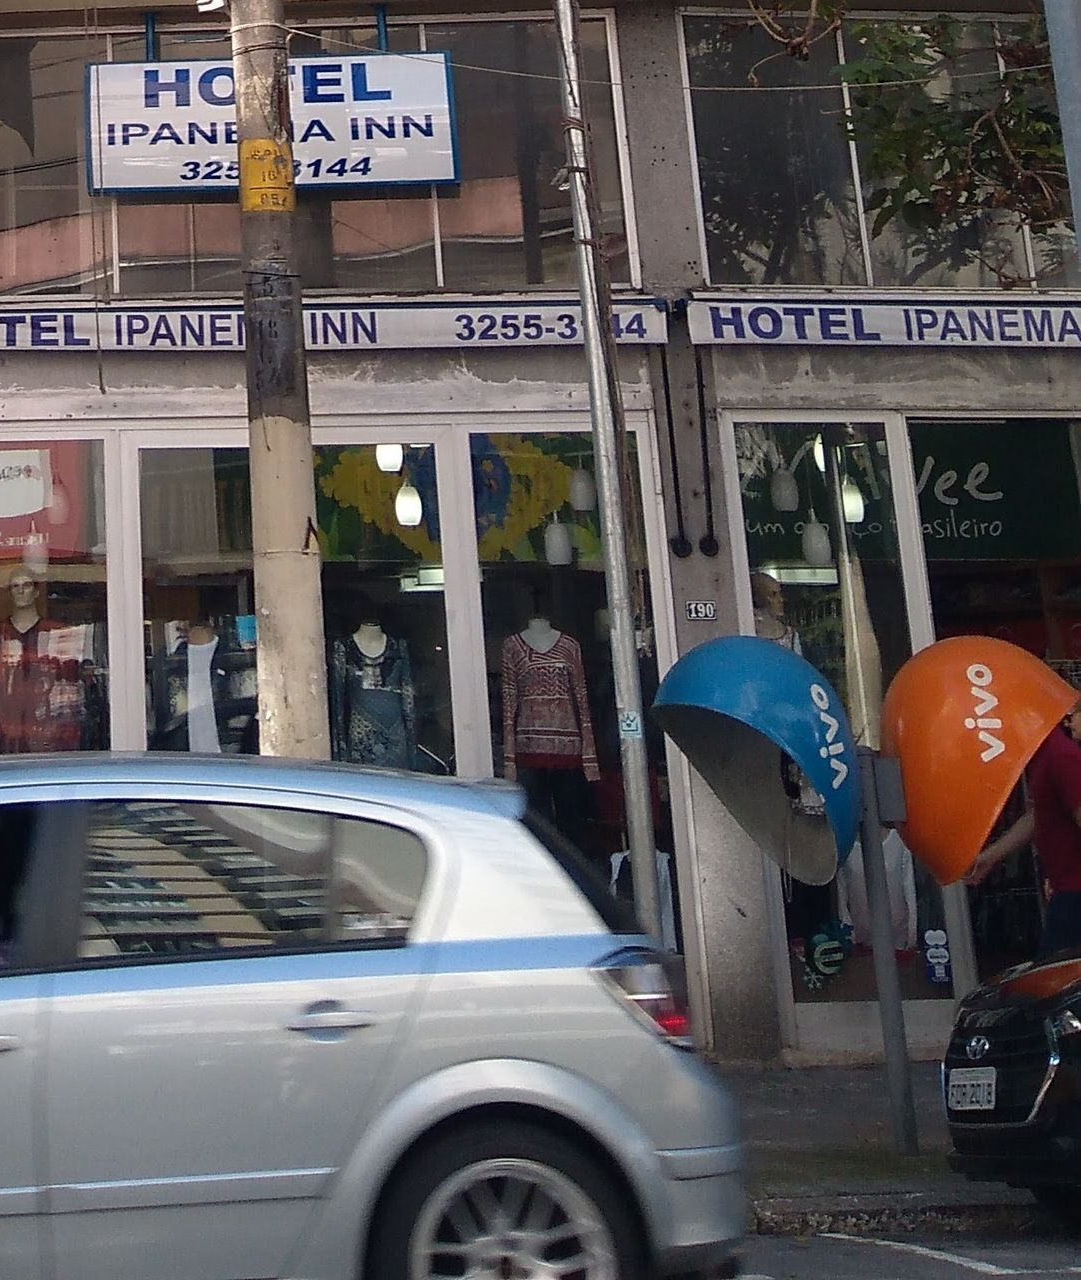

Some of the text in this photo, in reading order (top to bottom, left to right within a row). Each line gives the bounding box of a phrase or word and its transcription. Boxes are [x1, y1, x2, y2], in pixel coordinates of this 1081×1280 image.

[143, 62, 392, 108] HOEL
[106, 114, 435, 146] IPANEA INN
[114, 312, 247, 347] IPANE
[310, 310, 379, 345] INN
[710, 306, 1081, 342] HOTEL IPANEMA
[689, 603, 715, 618] 190
[964, 663, 1006, 763] vivo
[810, 683, 849, 790] vivo
